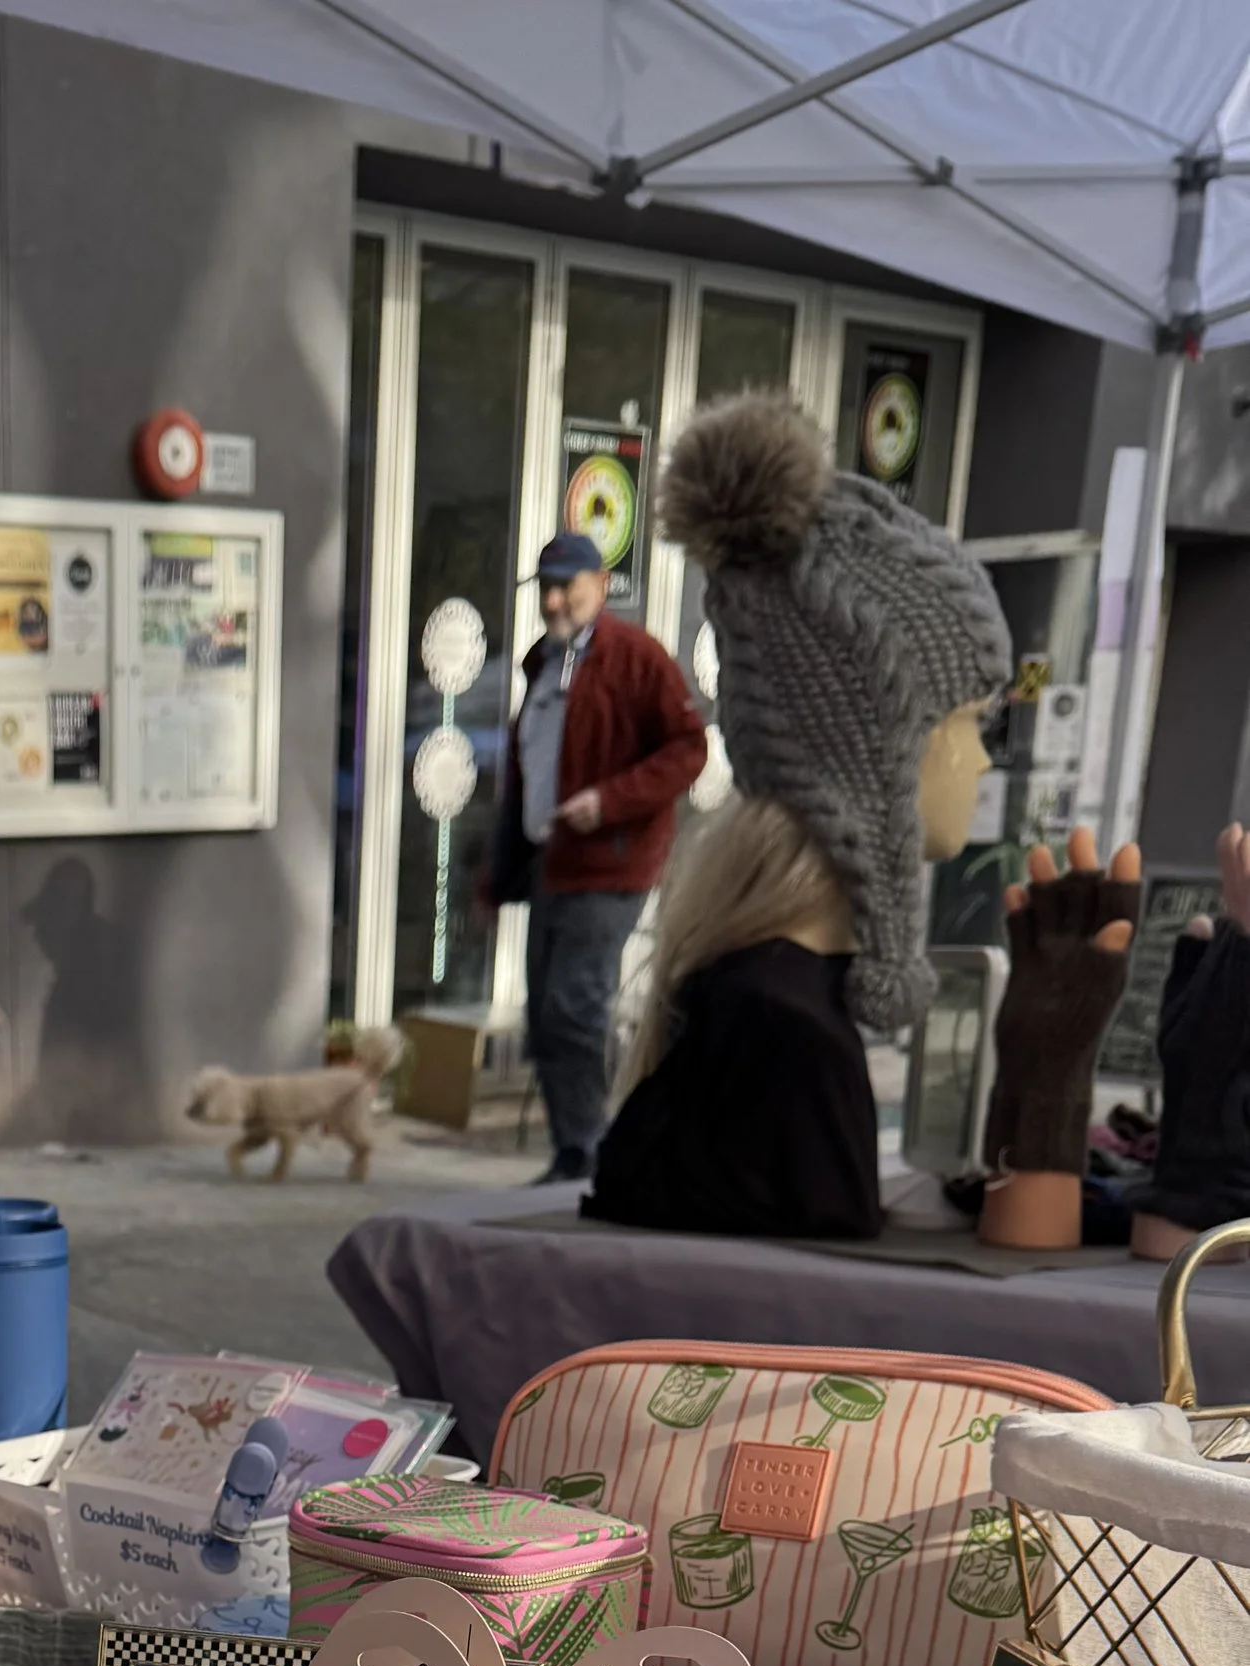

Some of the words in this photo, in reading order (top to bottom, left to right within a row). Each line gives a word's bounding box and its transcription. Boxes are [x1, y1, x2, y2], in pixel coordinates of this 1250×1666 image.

[744, 1458, 814, 1479] TENDER
[738, 1480, 796, 1499] LOVE
[80, 1503, 145, 1533] Cocktail
[734, 1501, 806, 1521] CARRY
[120, 1539, 142, 1563] $5
[143, 1549, 180, 1574] each
